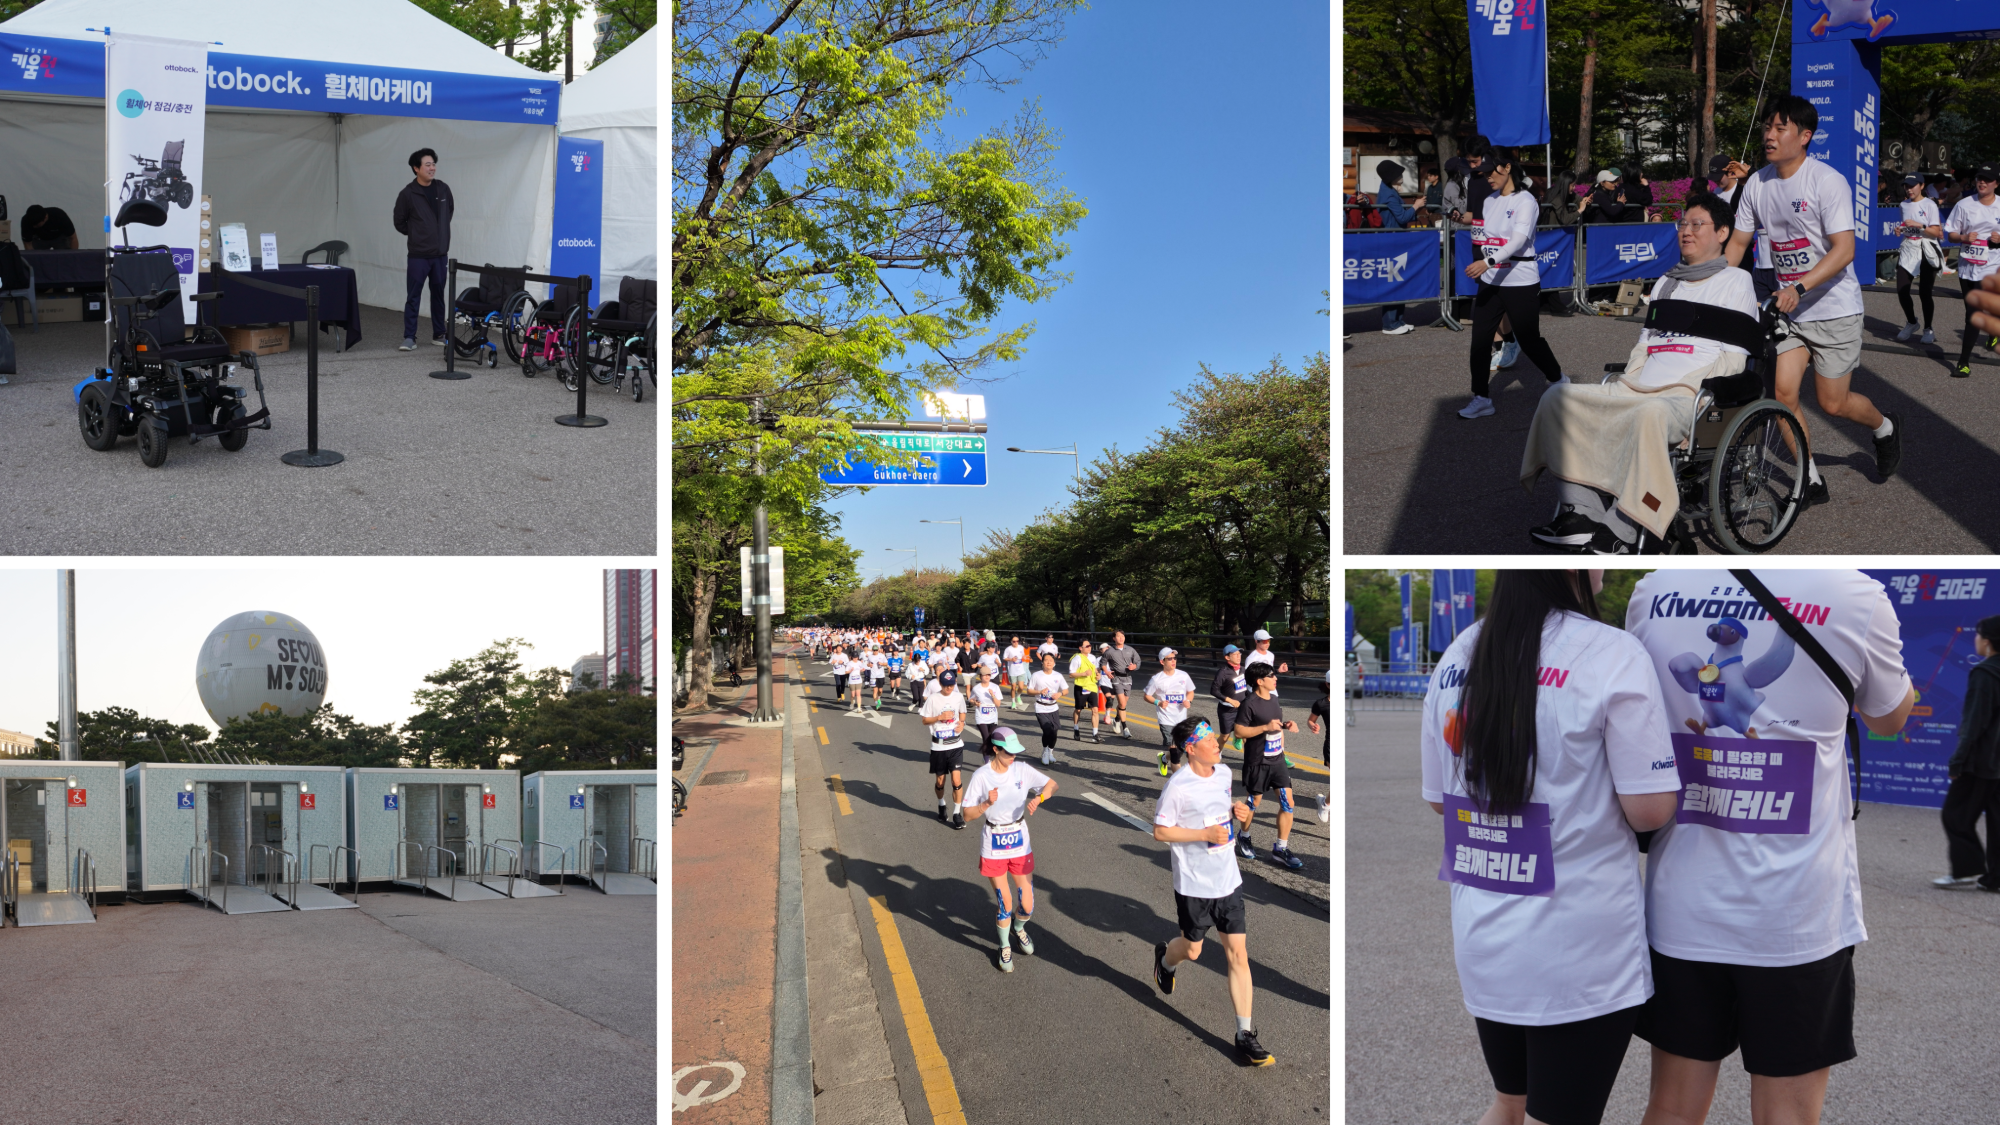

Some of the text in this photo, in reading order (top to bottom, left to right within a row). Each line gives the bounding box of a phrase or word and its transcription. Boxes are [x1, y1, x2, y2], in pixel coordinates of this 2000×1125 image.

[1807, 62, 1834, 73] bigwalk
[325, 73, 432, 105] 휠체어케어
[125, 97, 193, 114] 휠체어 점검/충전
[1855, 165, 1870, 242] 2026
[558, 238, 596, 247] ottobock.
[1964, 246, 1984, 256] 3517
[1775, 251, 1810, 267] 3513
[891, 437, 931, 449] 올림픽대로
[935, 439, 978, 450] 서강대교
[874, 469, 943, 481] Gukhoe-daero
[1710, 586, 1756, 597] 202
[1934, 577, 1988, 600] 2026
[1693, 746, 1783, 766] 도움이 필요할 때
[1706, 763, 1764, 781] 불러주세요
[1682, 782, 1795, 821] 함께러너
[1457, 808, 1524, 828] 도움이 필요할 때
[995, 832, 1019, 846] 1607
[1467, 825, 1508, 843] 불러주세요
[1453, 843, 1538, 883] 함께러너
